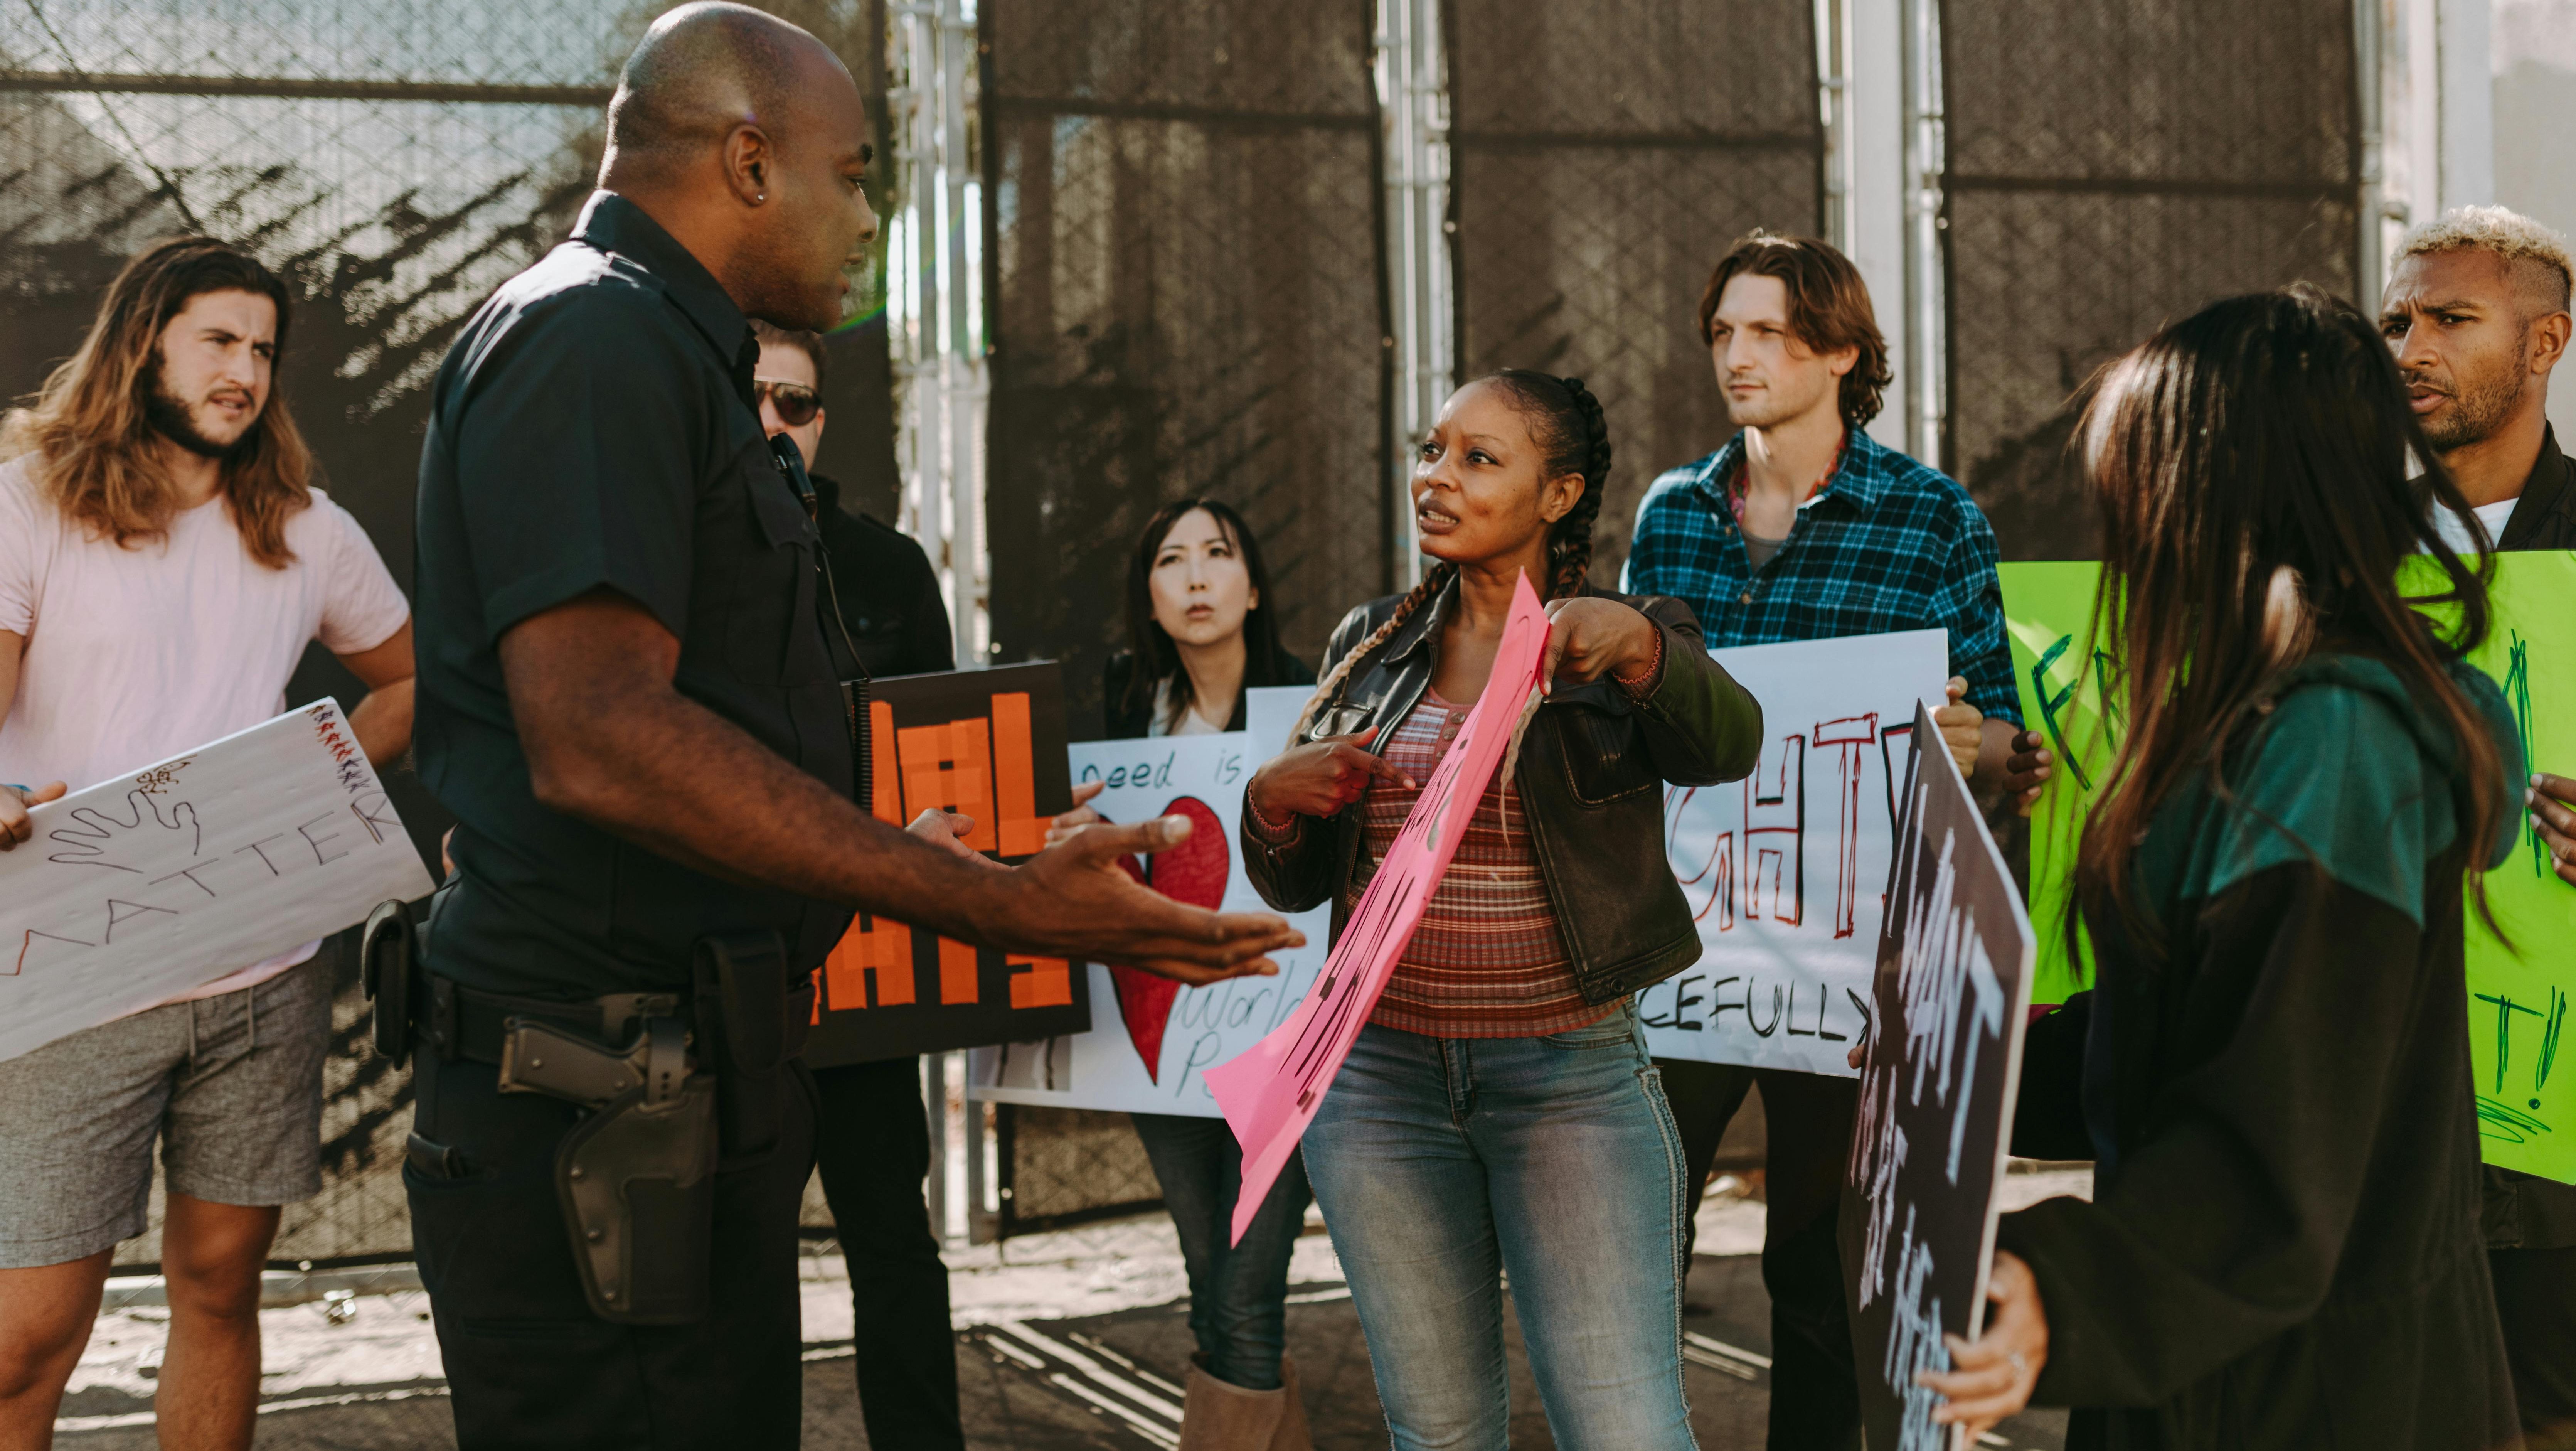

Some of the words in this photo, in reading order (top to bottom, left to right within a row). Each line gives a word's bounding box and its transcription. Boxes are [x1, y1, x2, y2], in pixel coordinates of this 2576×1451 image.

[1081, 750, 1175, 789] need
[1214, 748, 1242, 785] is
[1664, 711, 1914, 940] GHT
[1887, 748, 1921, 939] I
[1639, 974, 1871, 1046] CEFULLY
[1898, 783, 2005, 1188] WANT
[2474, 985, 2566, 1110] T!
[1174, 1031, 1215, 1099] P
